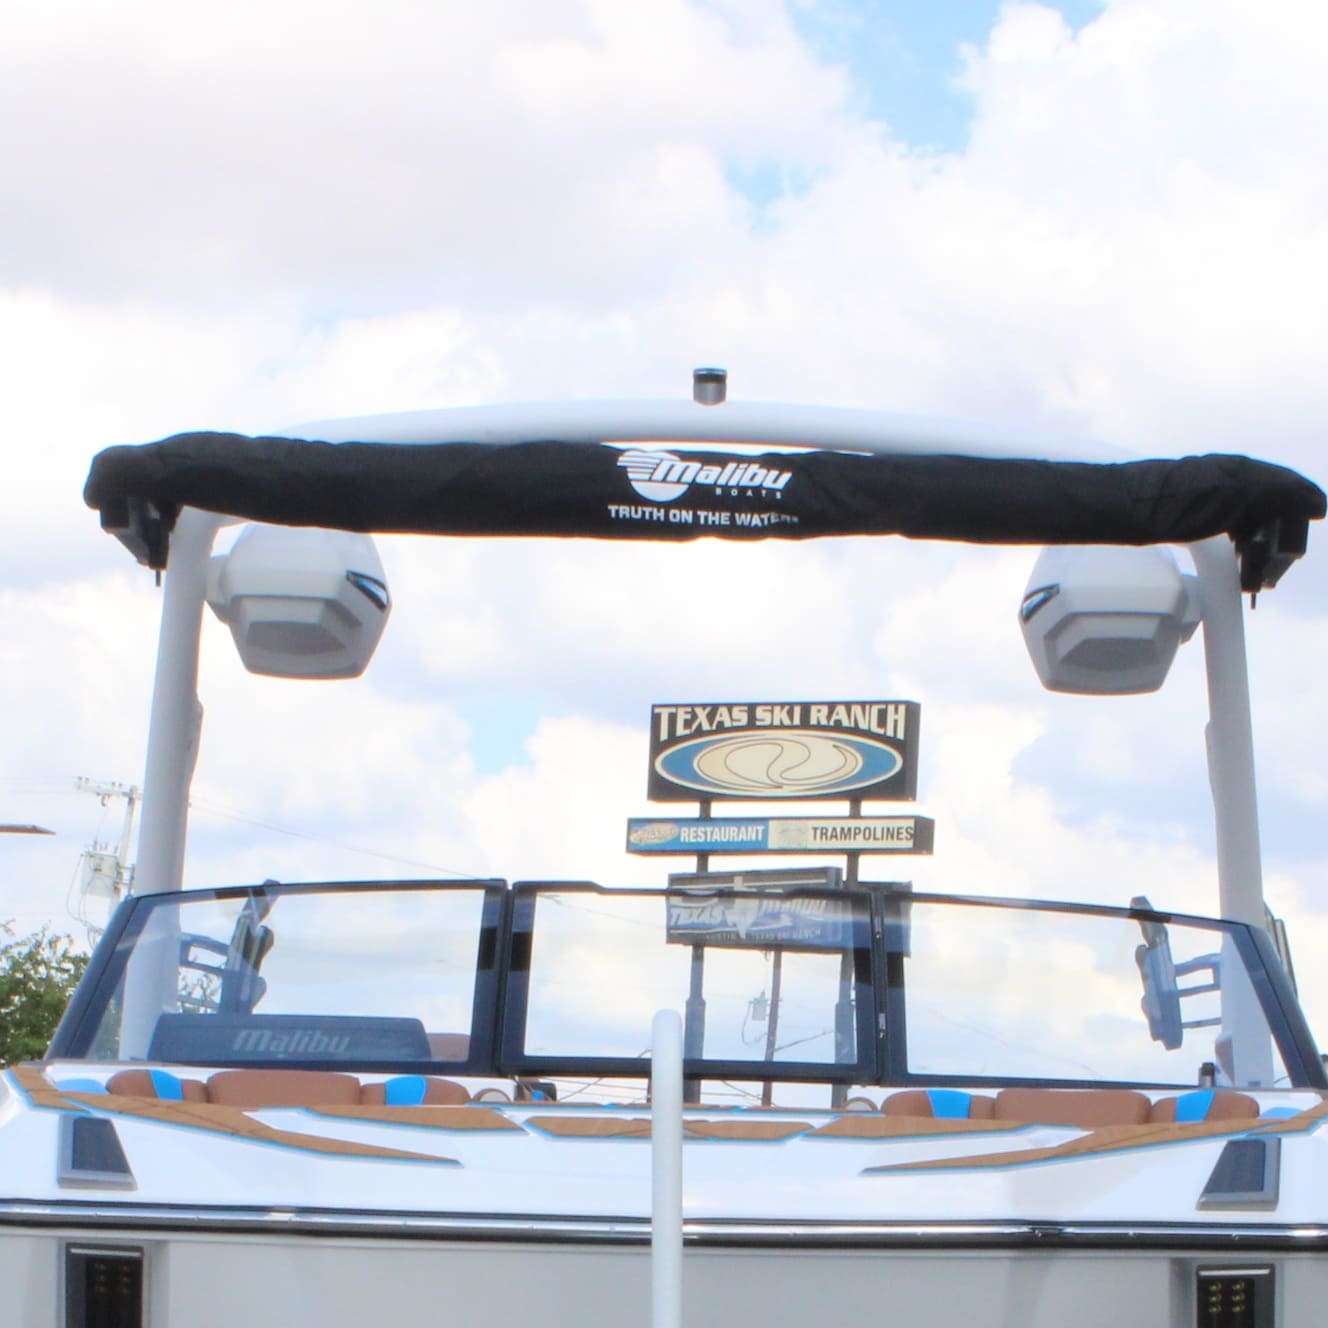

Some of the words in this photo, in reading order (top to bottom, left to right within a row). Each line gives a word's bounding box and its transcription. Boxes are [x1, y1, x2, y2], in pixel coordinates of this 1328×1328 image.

[649, 458, 793, 490] Malibu
[715, 487, 782, 500] BOATS
[607, 504, 665, 522] TRUTH
[669, 509, 693, 525] ON
[697, 510, 731, 526] THE
[653, 705, 748, 742] TEXAS
[755, 704, 801, 727] SKI
[809, 703, 907, 741] RANCH
[679, 825, 765, 843] RESTAURANT
[811, 825, 915, 842] TRAMPOLINES
[232, 1028, 351, 1053] Malibu
